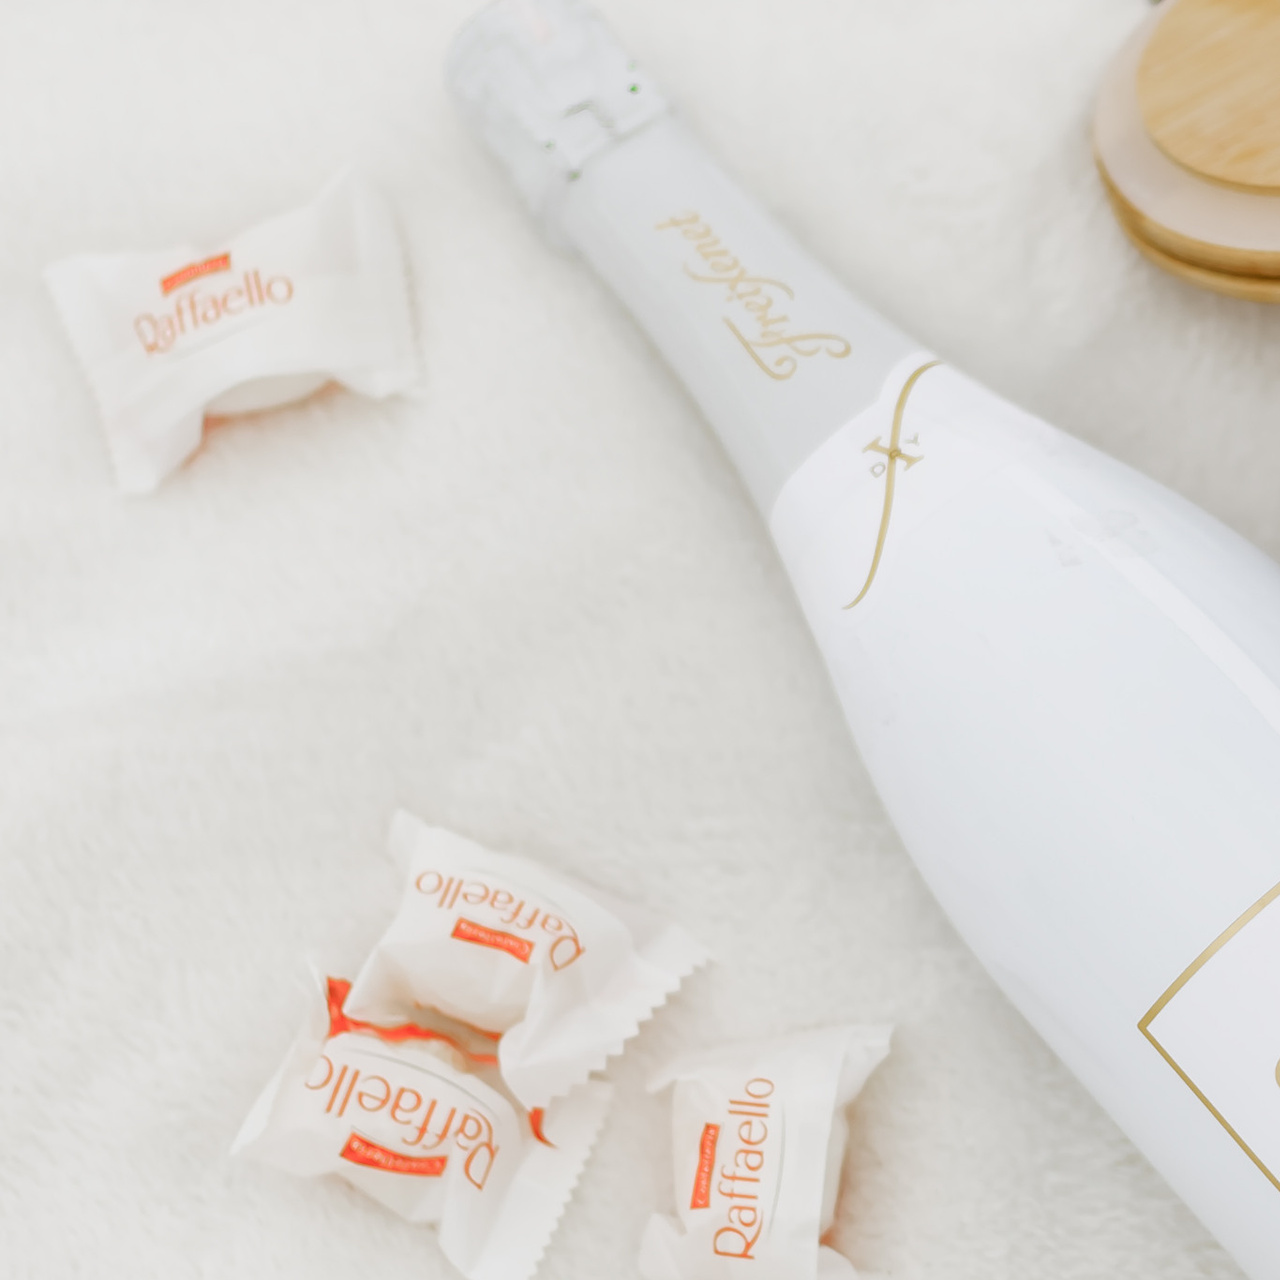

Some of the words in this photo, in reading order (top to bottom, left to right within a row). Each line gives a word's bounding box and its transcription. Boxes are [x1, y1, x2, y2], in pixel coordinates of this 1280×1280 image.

[132, 269, 295, 358] Raffaello
[655, 211, 852, 381] Freixenet
[414, 869, 586, 972] Raffaello
[304, 1053, 501, 1191] Raffaello
[712, 1077, 775, 1260] Raffaello
